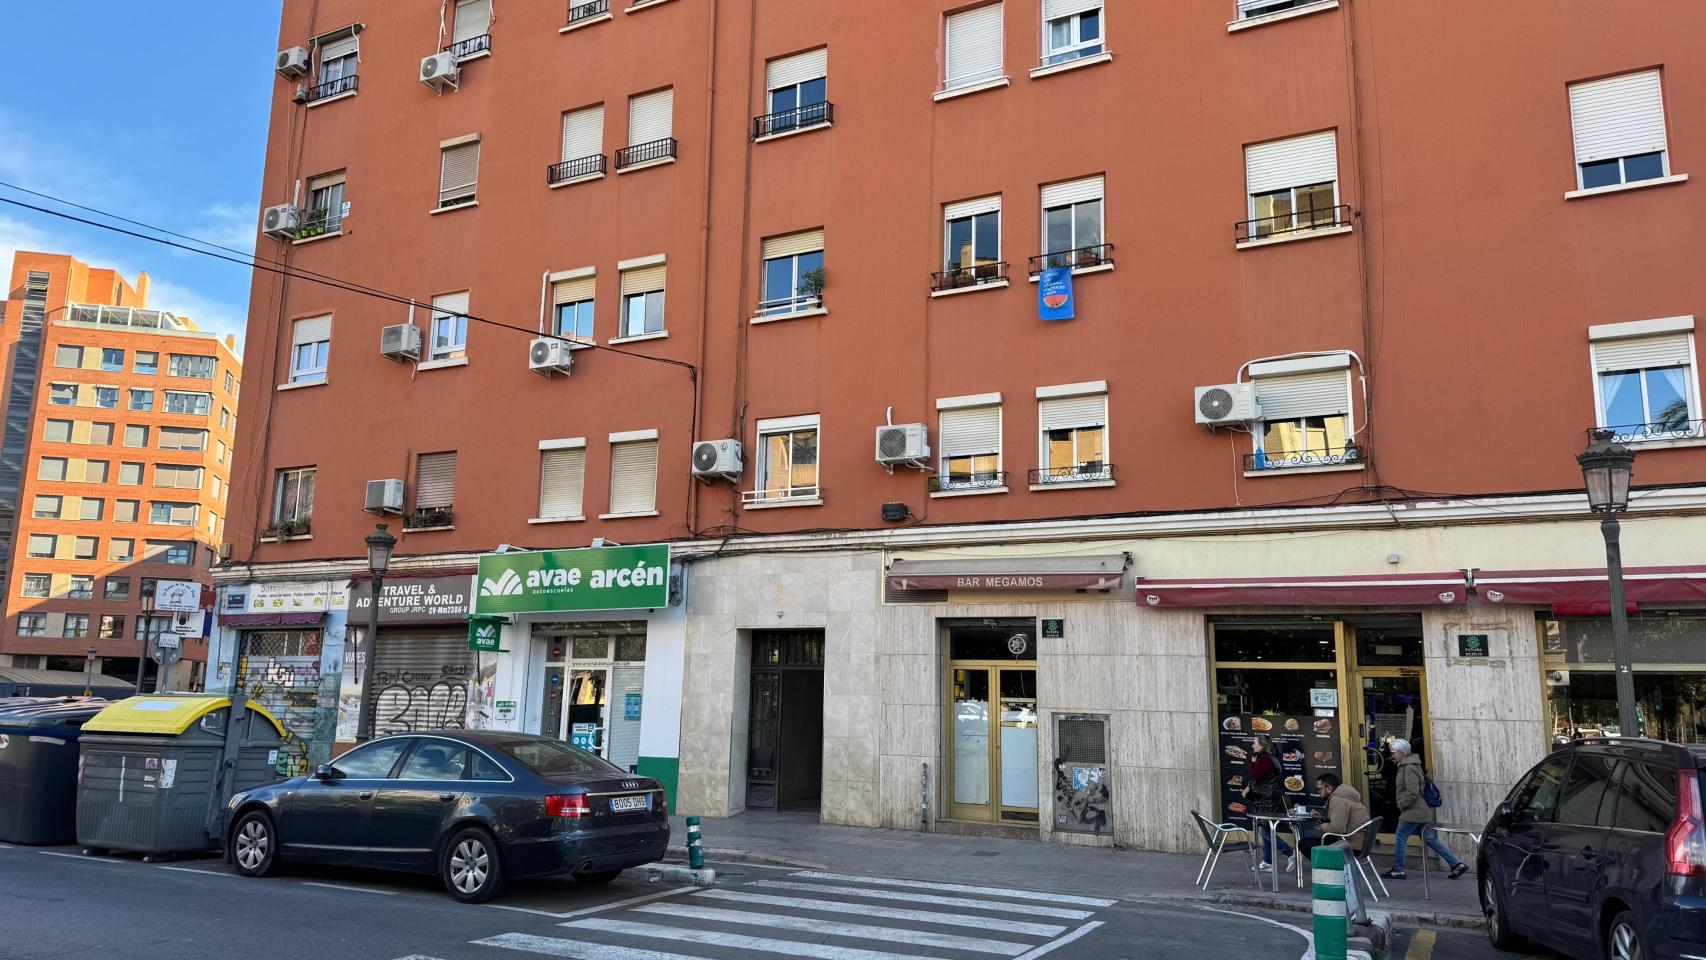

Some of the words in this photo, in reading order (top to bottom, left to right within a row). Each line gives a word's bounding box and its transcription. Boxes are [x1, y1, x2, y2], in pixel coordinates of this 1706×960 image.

[526, 567, 582, 588] avae
[589, 560, 663, 588] arcén
[957, 577, 980, 587] BAR
[986, 576, 1043, 587] MEGAMOS
[383, 585, 424, 596] TRAVEL
[428, 584, 436, 594] &
[356, 596, 421, 608] ADENTURE
[424, 594, 464, 606] WORLD
[389, 606, 410, 614] GROUP
[476, 637, 495, 646] avae
[345, 651, 366, 662] VIAES
[614, 798, 632, 808] 8005
